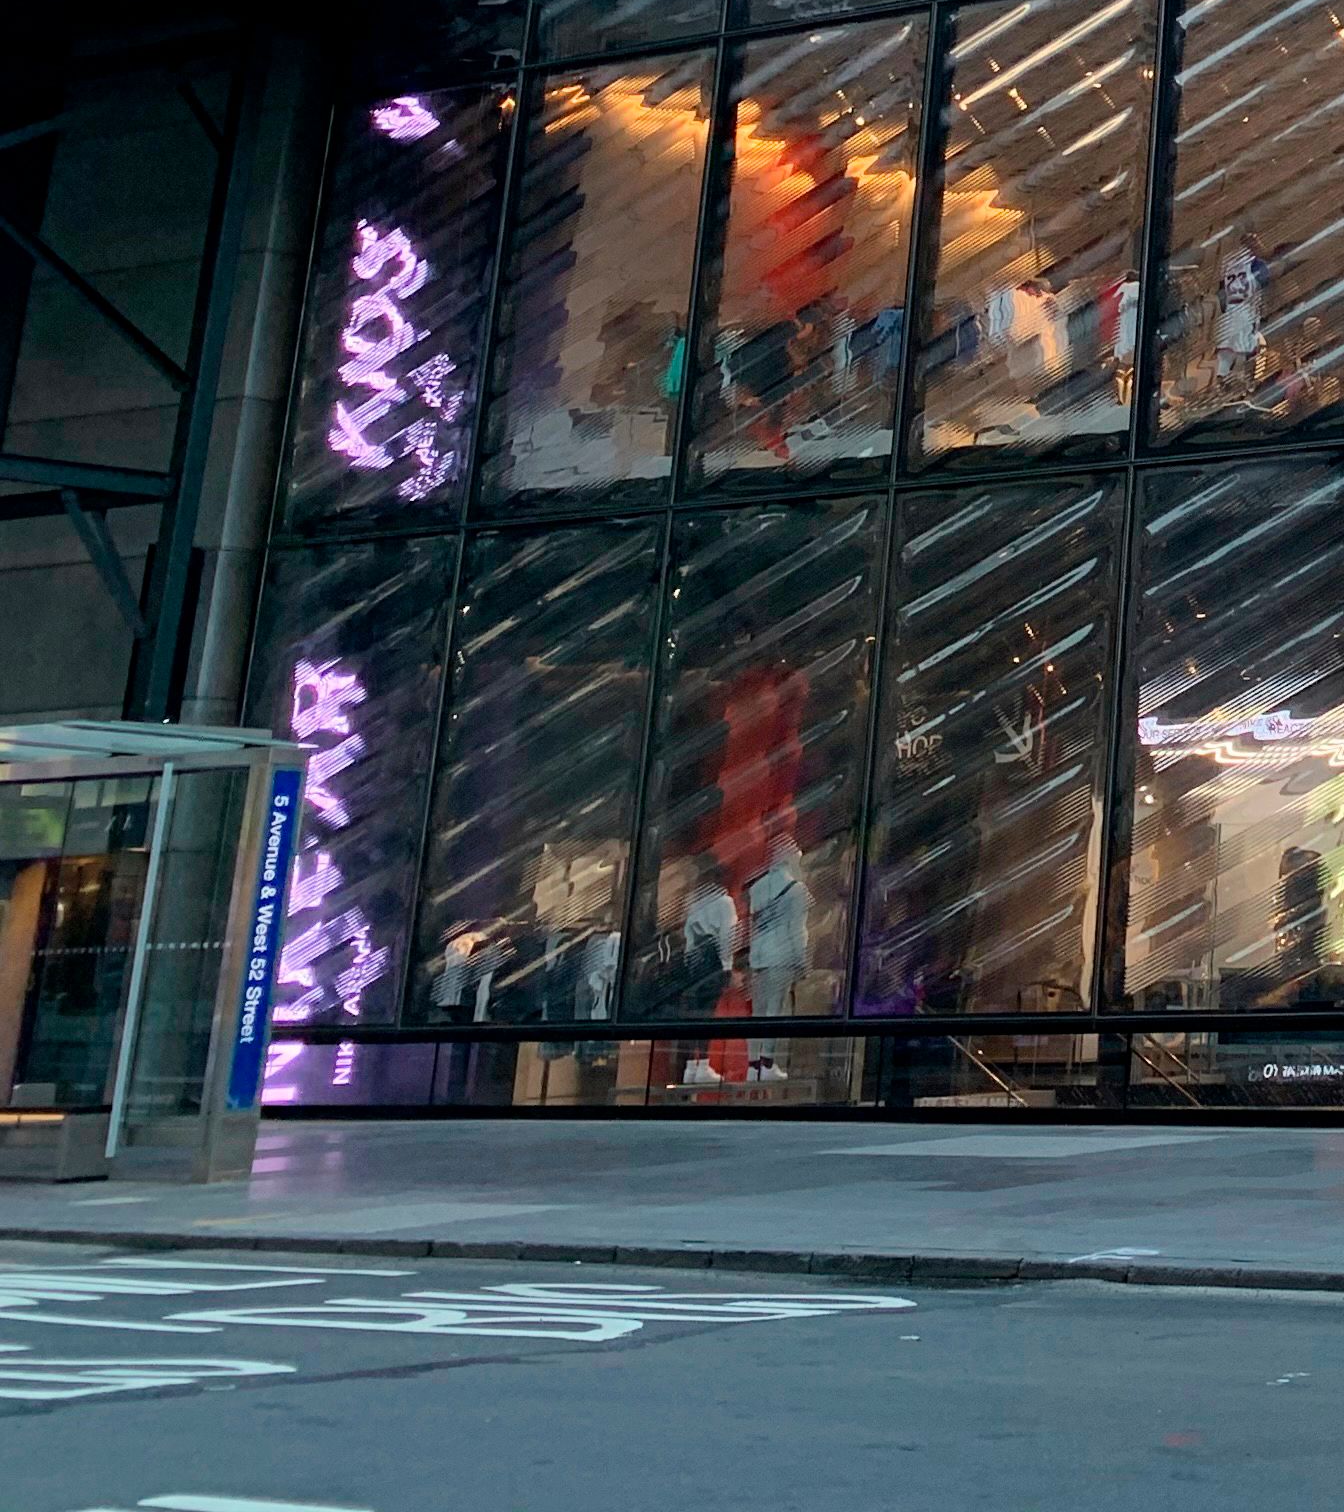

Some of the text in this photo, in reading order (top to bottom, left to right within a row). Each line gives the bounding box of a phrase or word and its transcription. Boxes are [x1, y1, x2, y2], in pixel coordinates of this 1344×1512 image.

[240, 795, 289, 1044] 5 Avenue & West 52 Street
[163, 1283, 918, 1342] BUS
